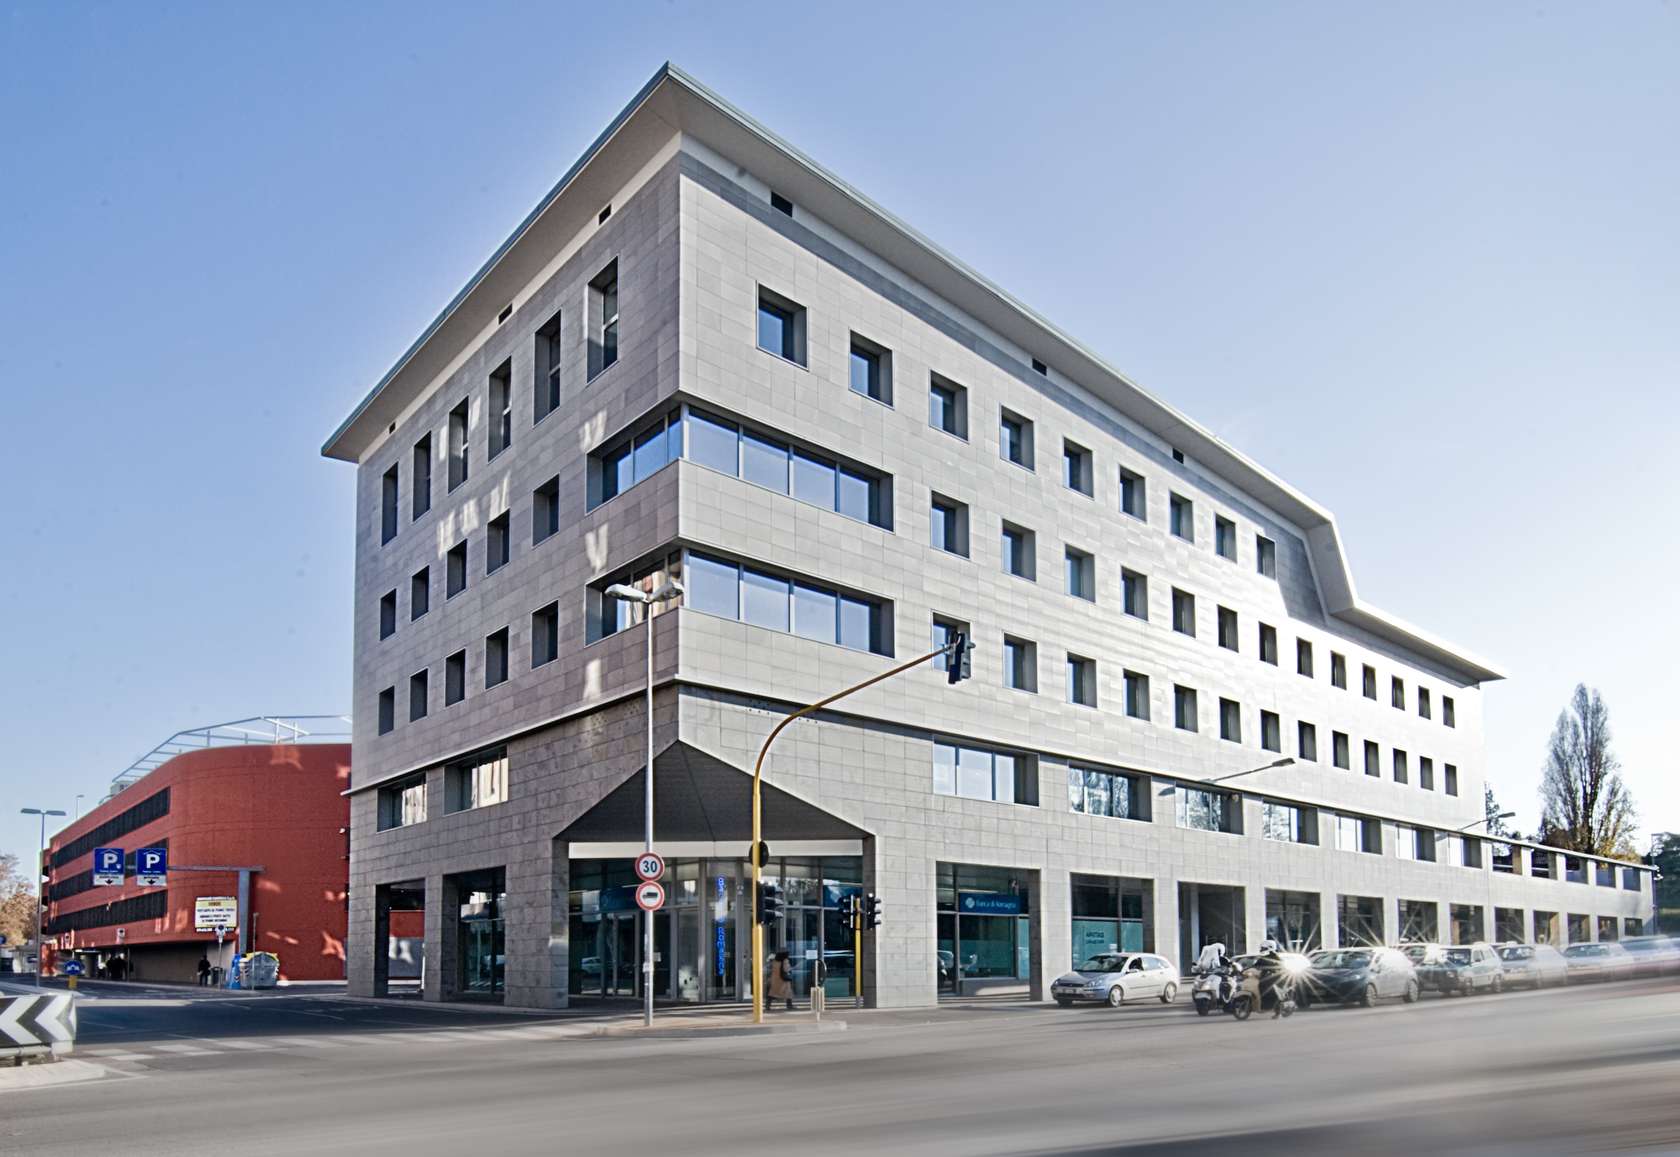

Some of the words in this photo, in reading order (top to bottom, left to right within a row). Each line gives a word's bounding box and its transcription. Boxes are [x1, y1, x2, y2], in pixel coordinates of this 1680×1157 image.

[104, 853, 118, 869] P
[146, 853, 160, 869] P
[642, 860, 658, 873] 30
